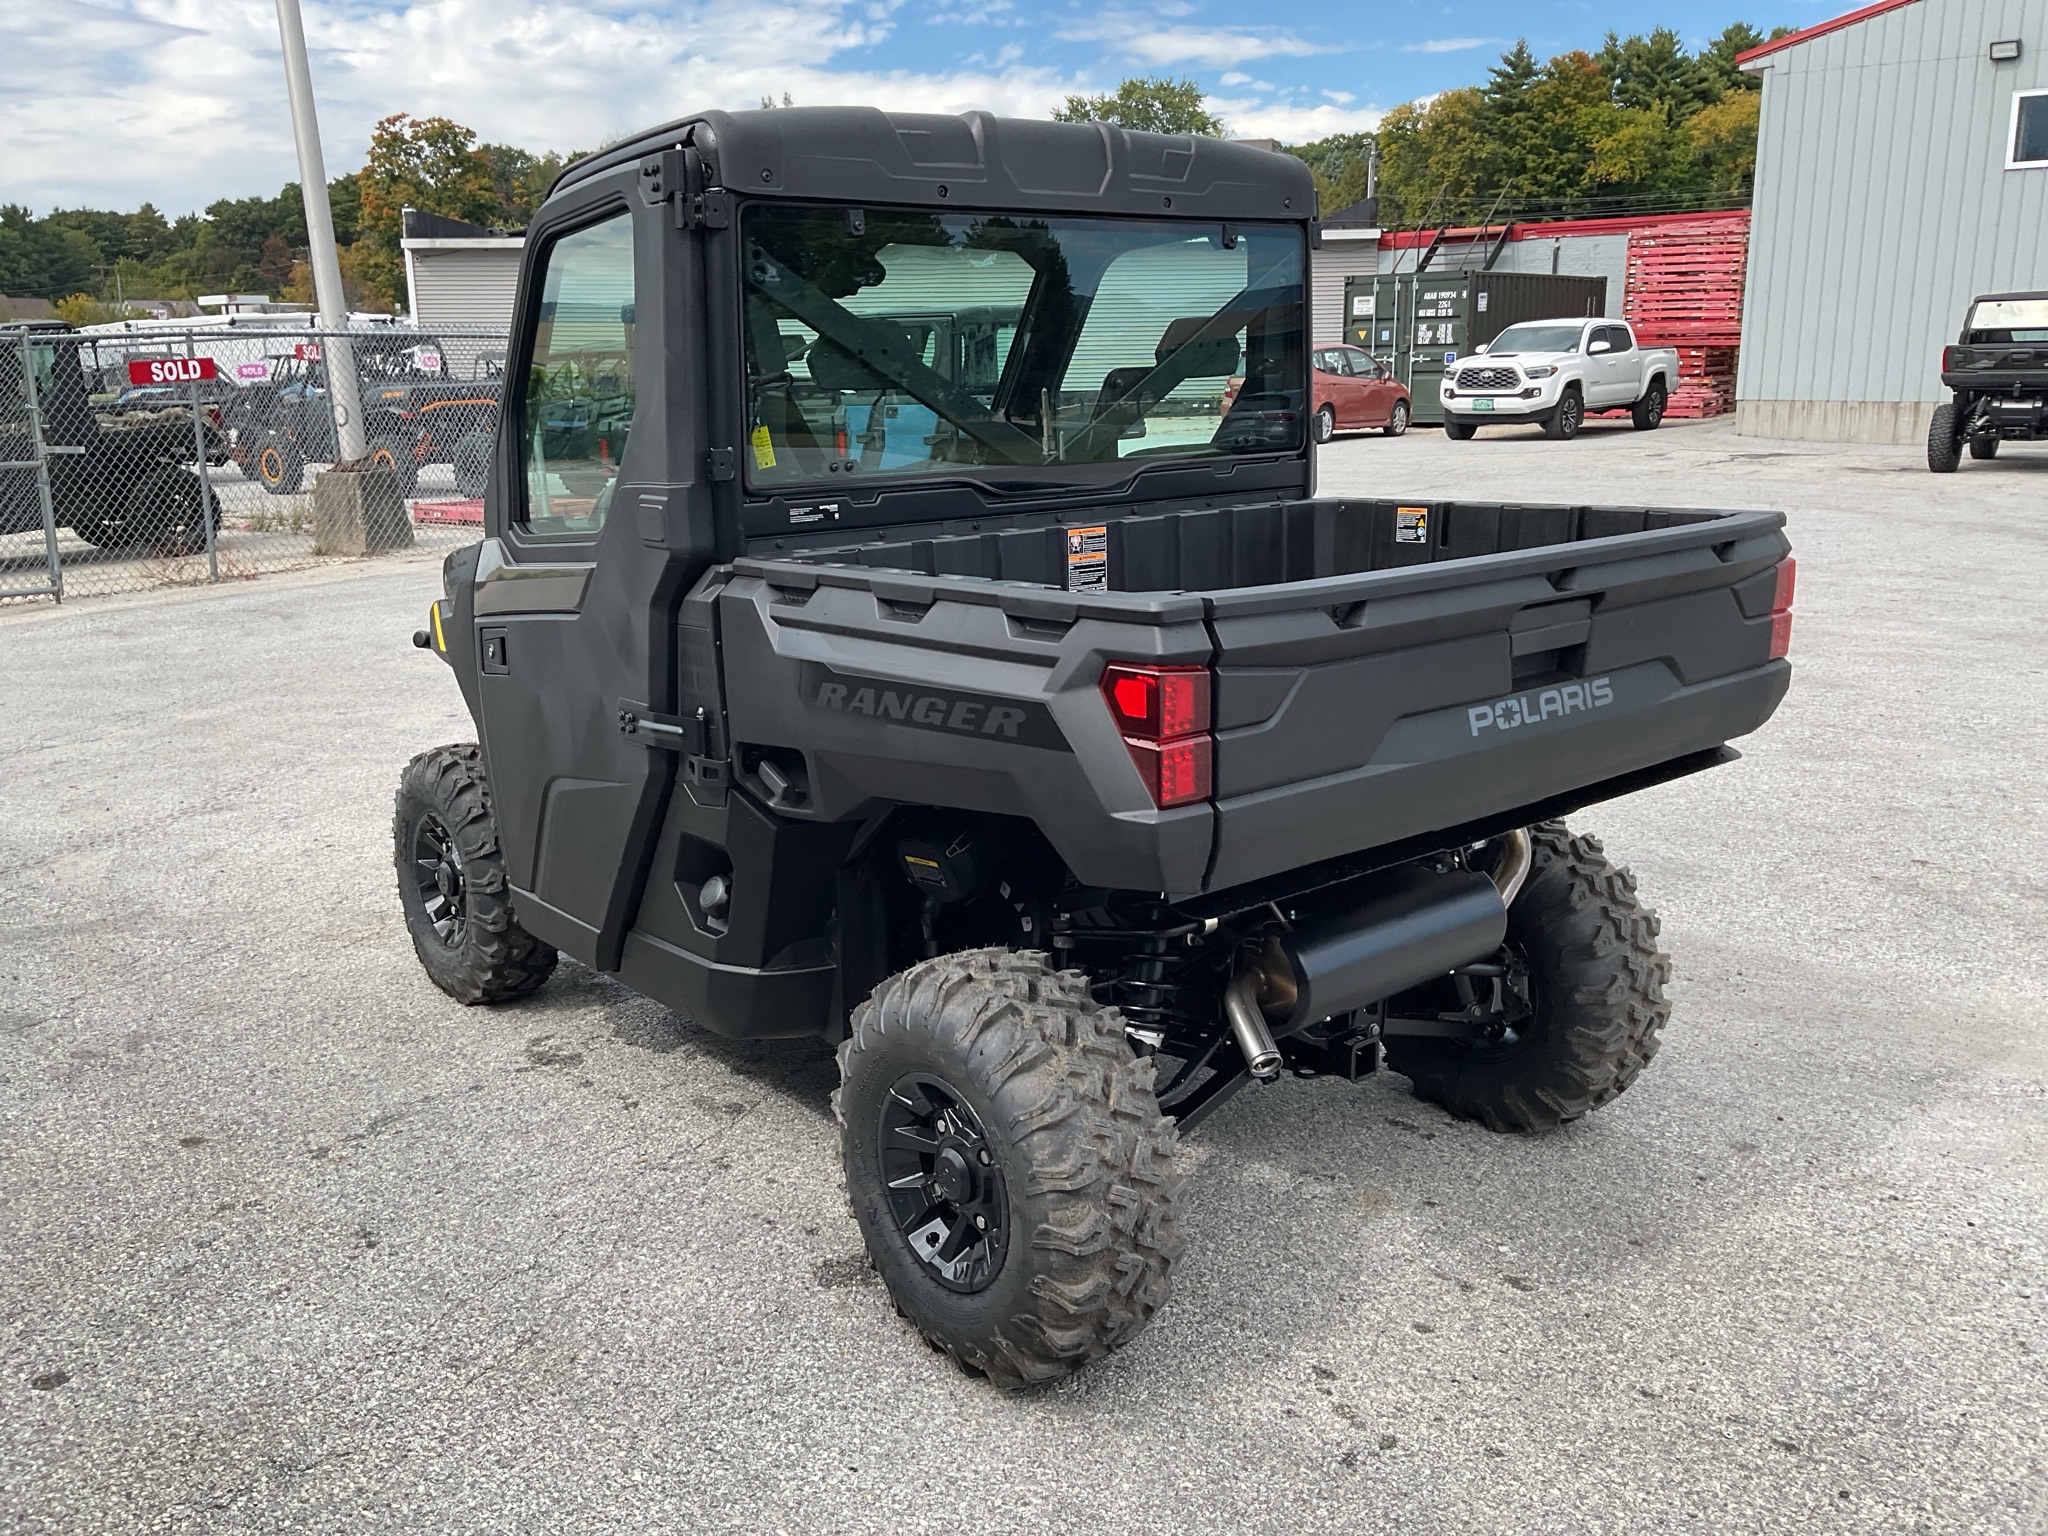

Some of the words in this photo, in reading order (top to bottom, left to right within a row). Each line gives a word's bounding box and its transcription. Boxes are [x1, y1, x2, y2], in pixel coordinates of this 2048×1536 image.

[302, 345, 321, 360] SOL
[150, 360, 202, 382] SOLD
[241, 366, 264, 376] SOLD
[815, 682, 1026, 738] RANGER
[1467, 677, 1614, 737] POLARIS
